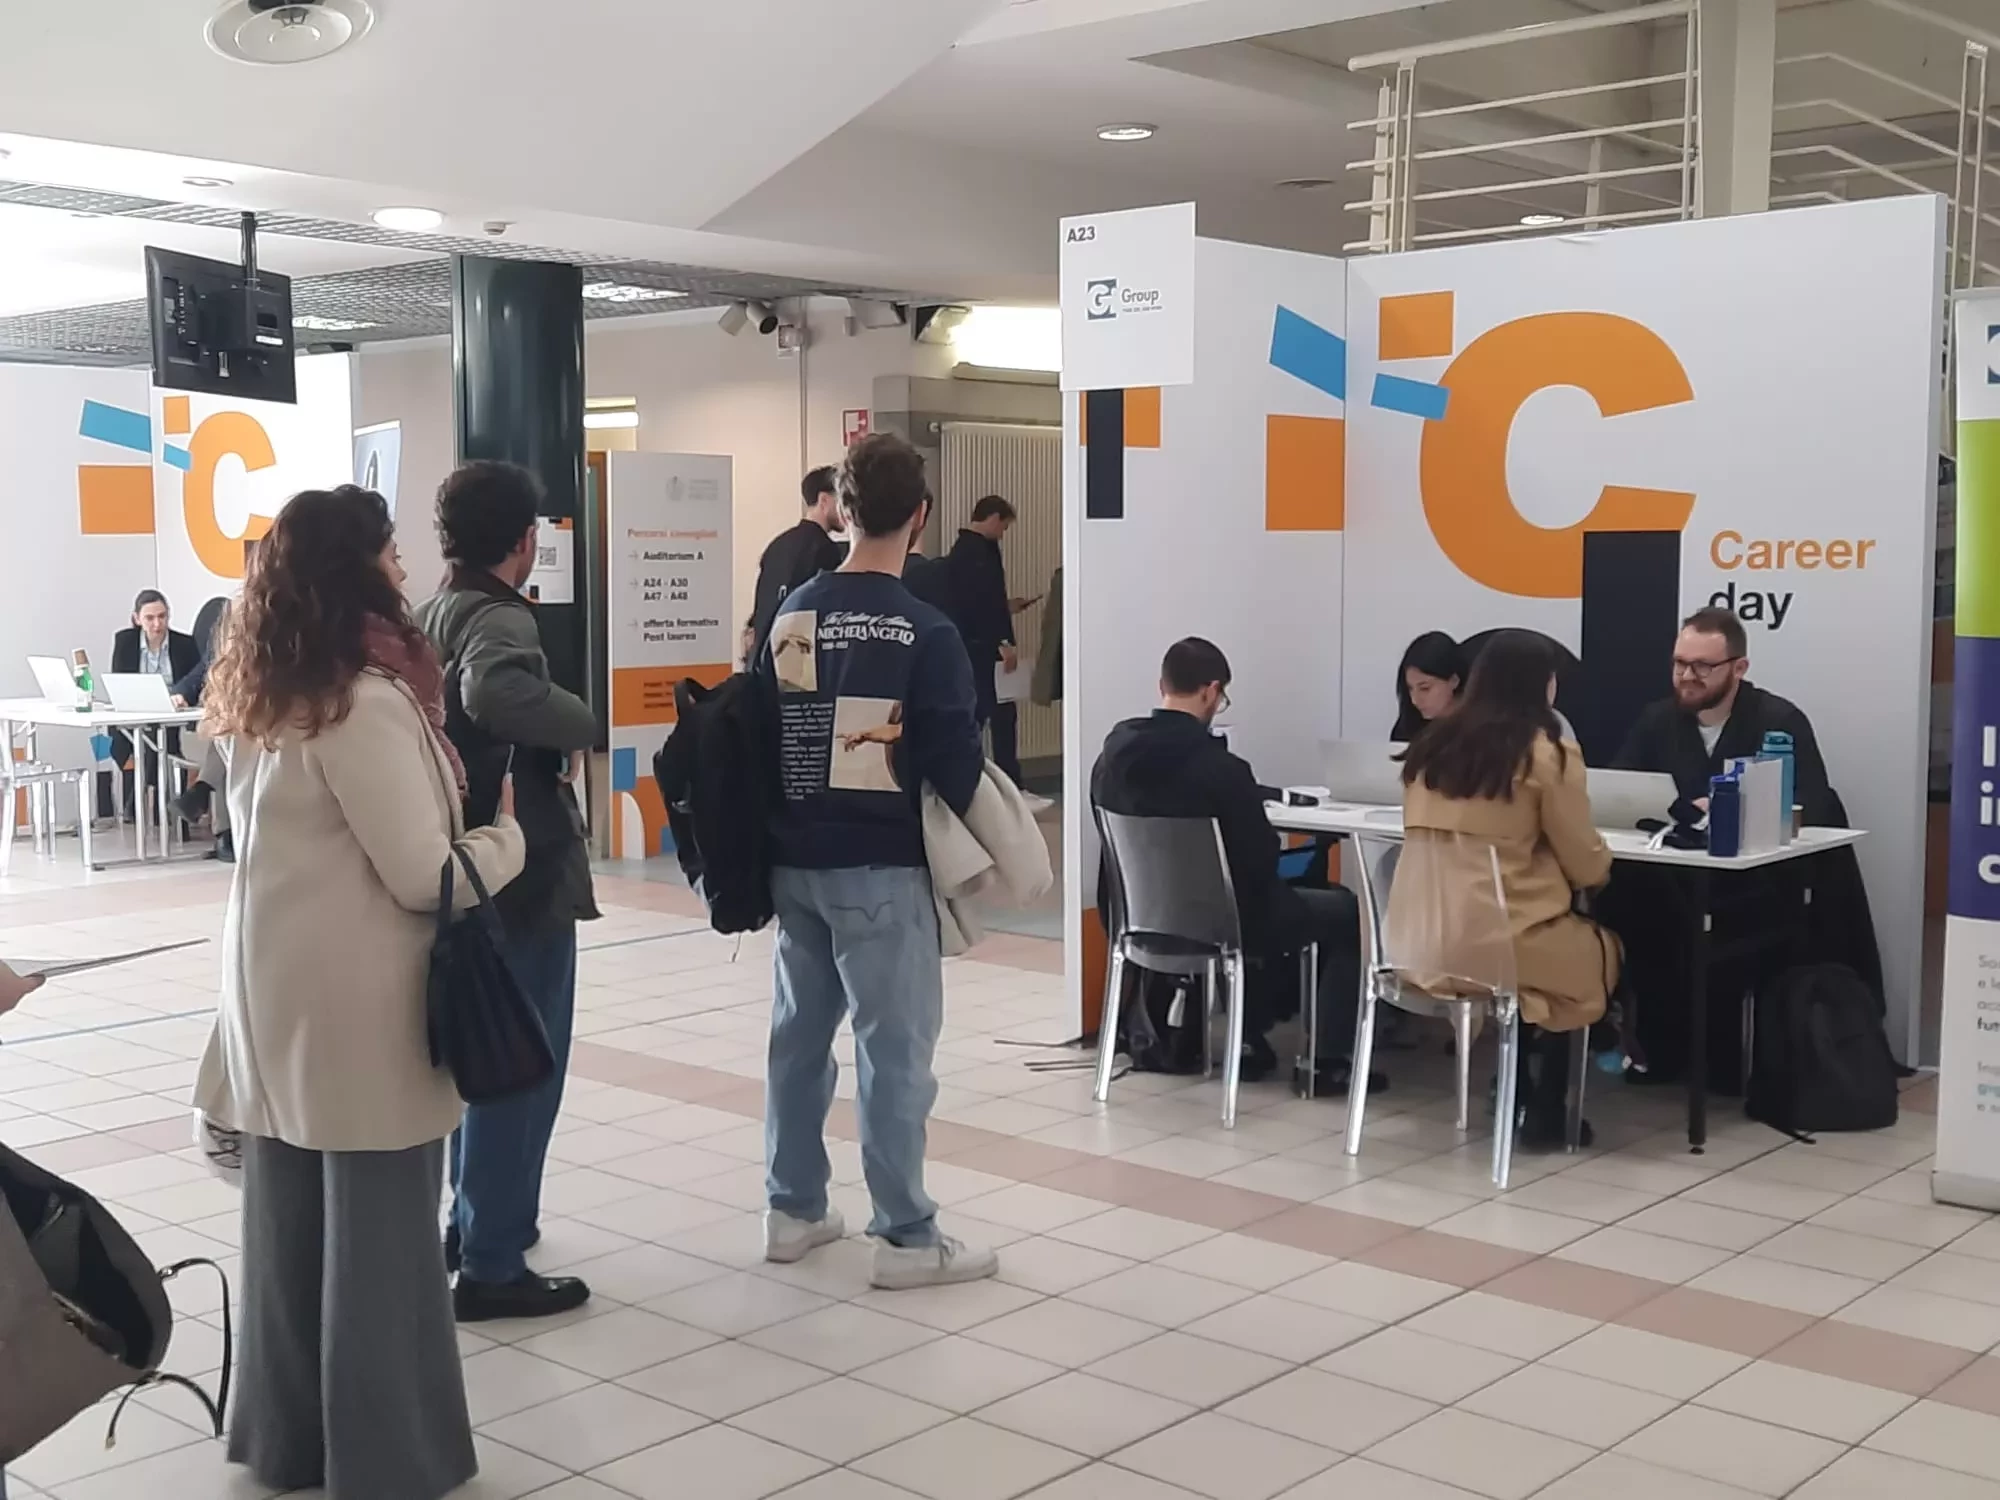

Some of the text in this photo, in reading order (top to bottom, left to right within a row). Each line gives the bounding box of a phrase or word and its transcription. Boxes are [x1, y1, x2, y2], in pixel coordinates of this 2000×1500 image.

[1067, 226, 1096, 243] A23
[1121, 288, 1159, 305] Group
[643, 551, 704, 561] Auditorium A
[1710, 530, 1876, 570] Career
[1708, 582, 1794, 630] day
[643, 617, 719, 629] offerta formativa
[817, 624, 915, 647] MICHELANGELO
